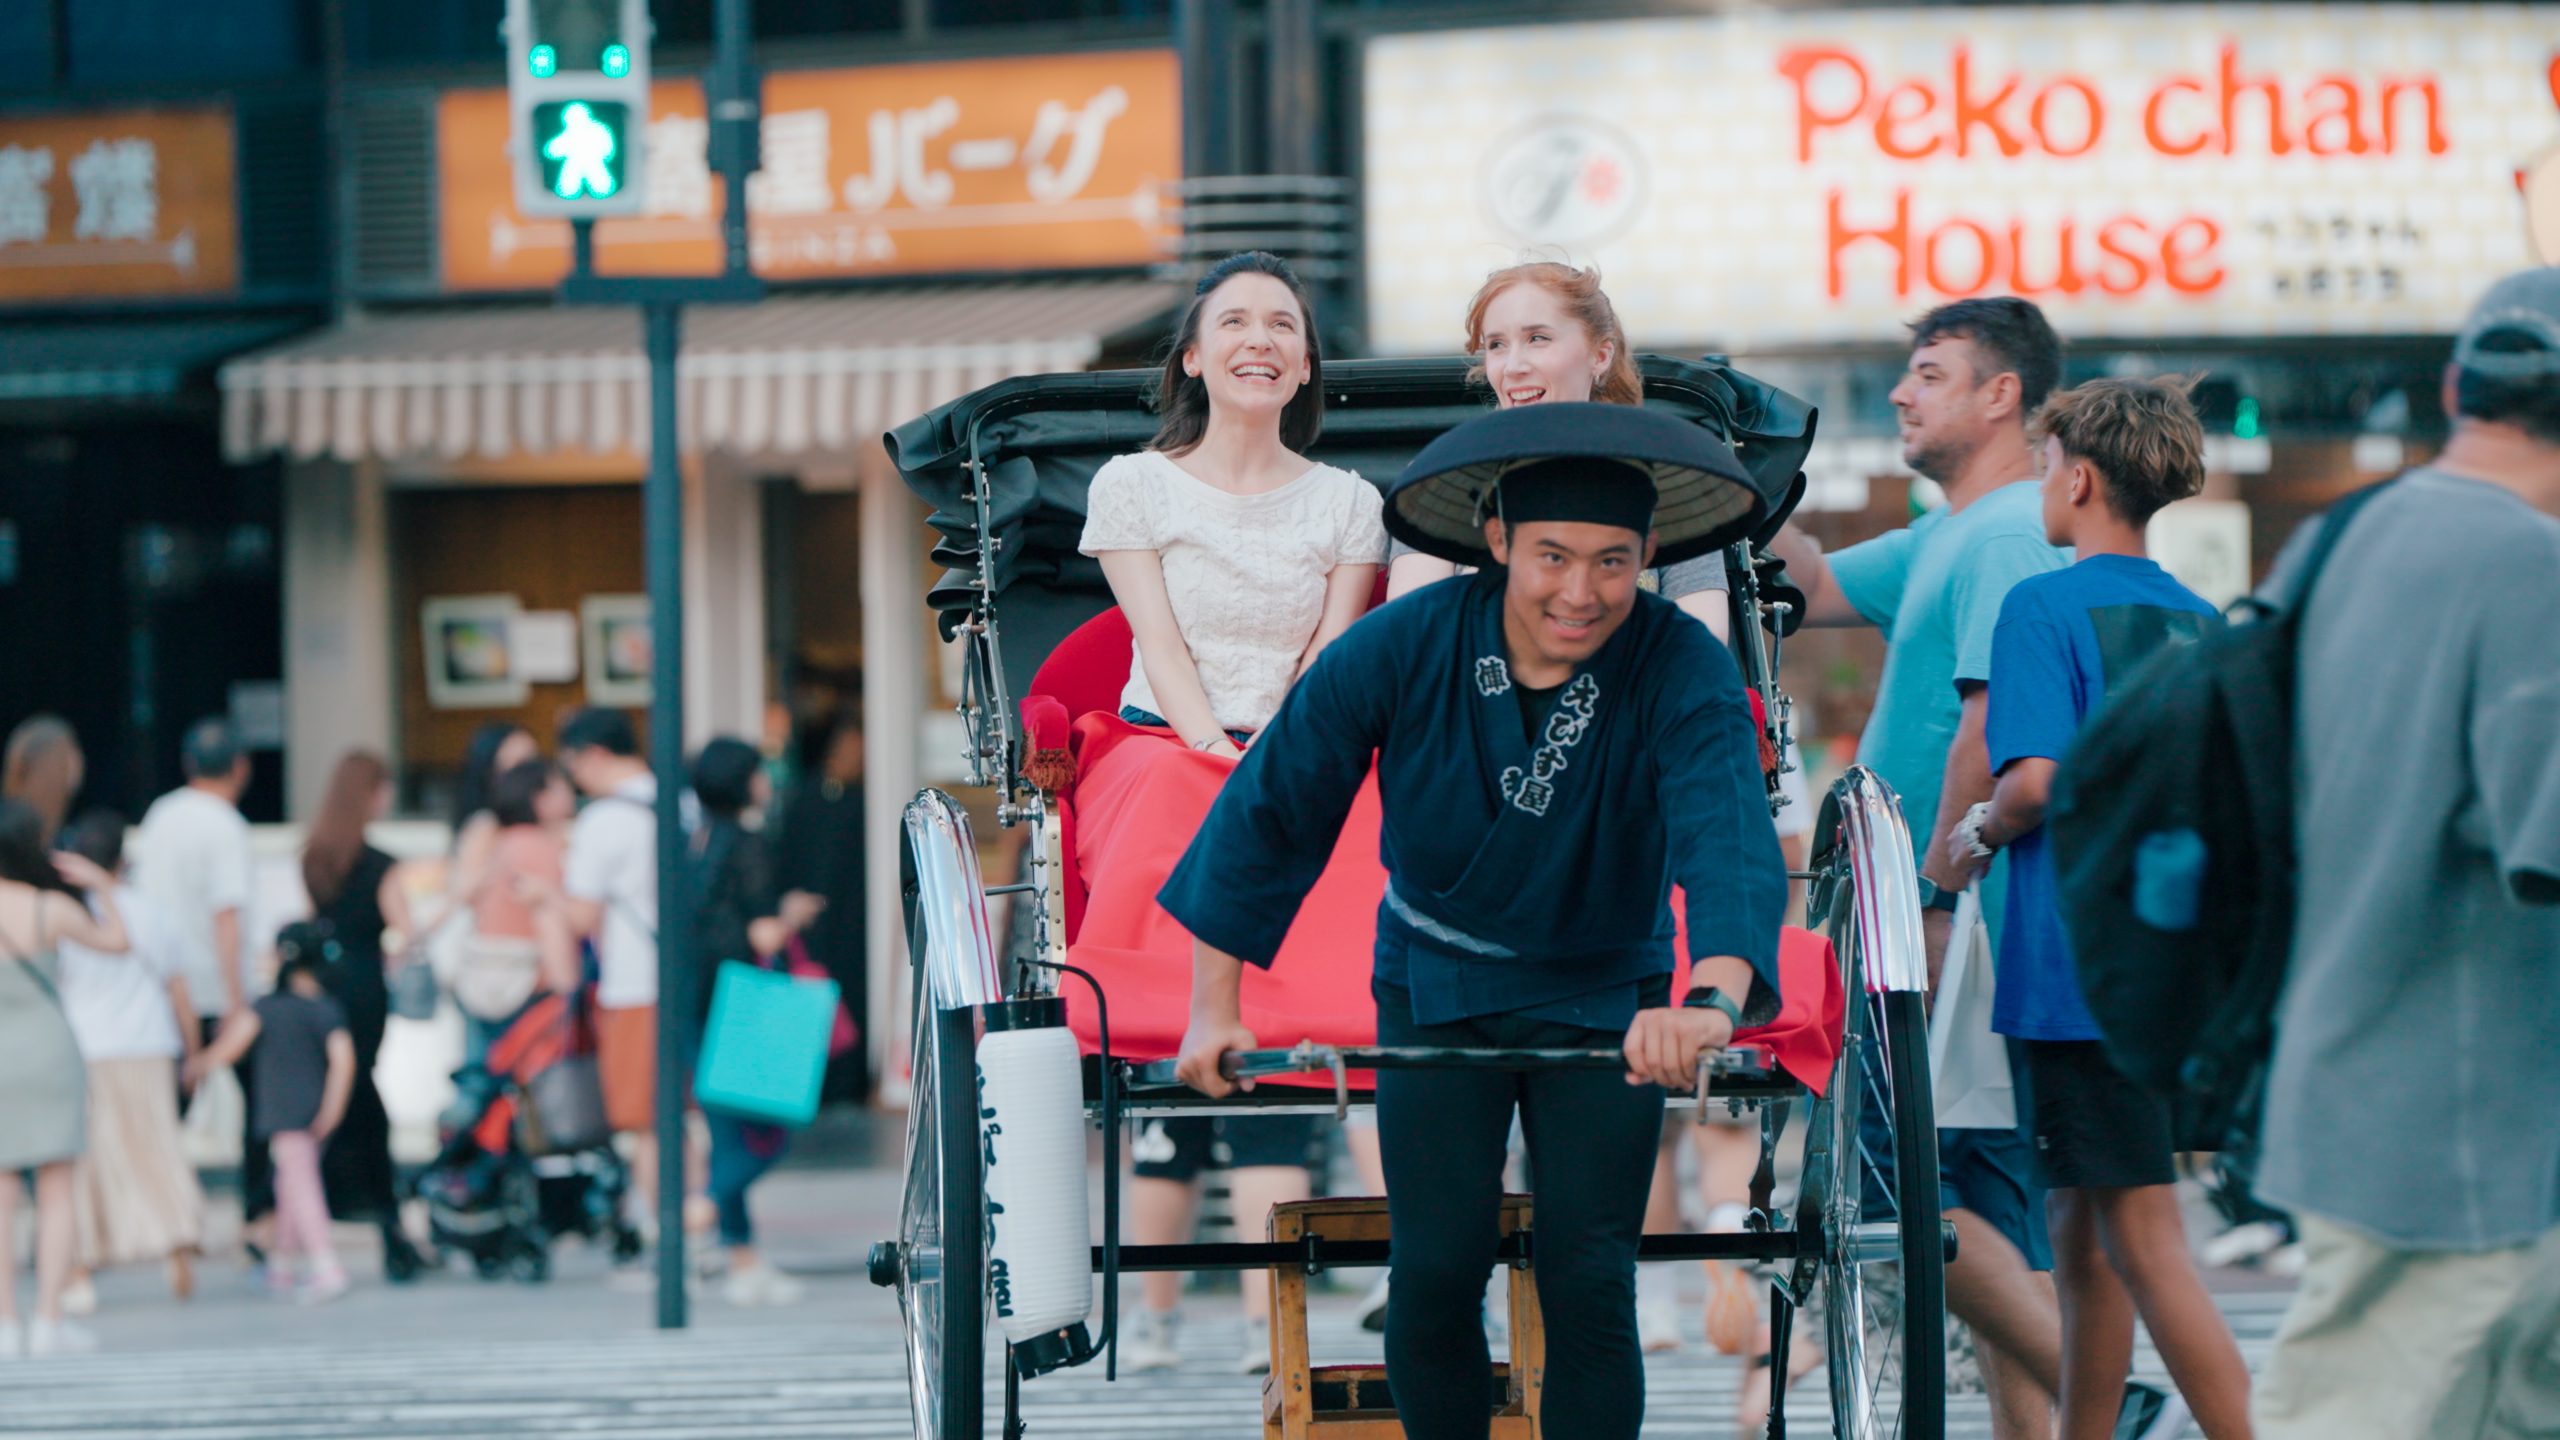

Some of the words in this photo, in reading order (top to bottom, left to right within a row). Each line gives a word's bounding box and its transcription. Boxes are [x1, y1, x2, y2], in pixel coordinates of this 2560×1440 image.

[1776, 44, 2106, 165] Peko
[2141, 42, 2451, 158] chan
[1825, 188, 2227, 301] House
[1513, 673, 1600, 817] えびす屋
